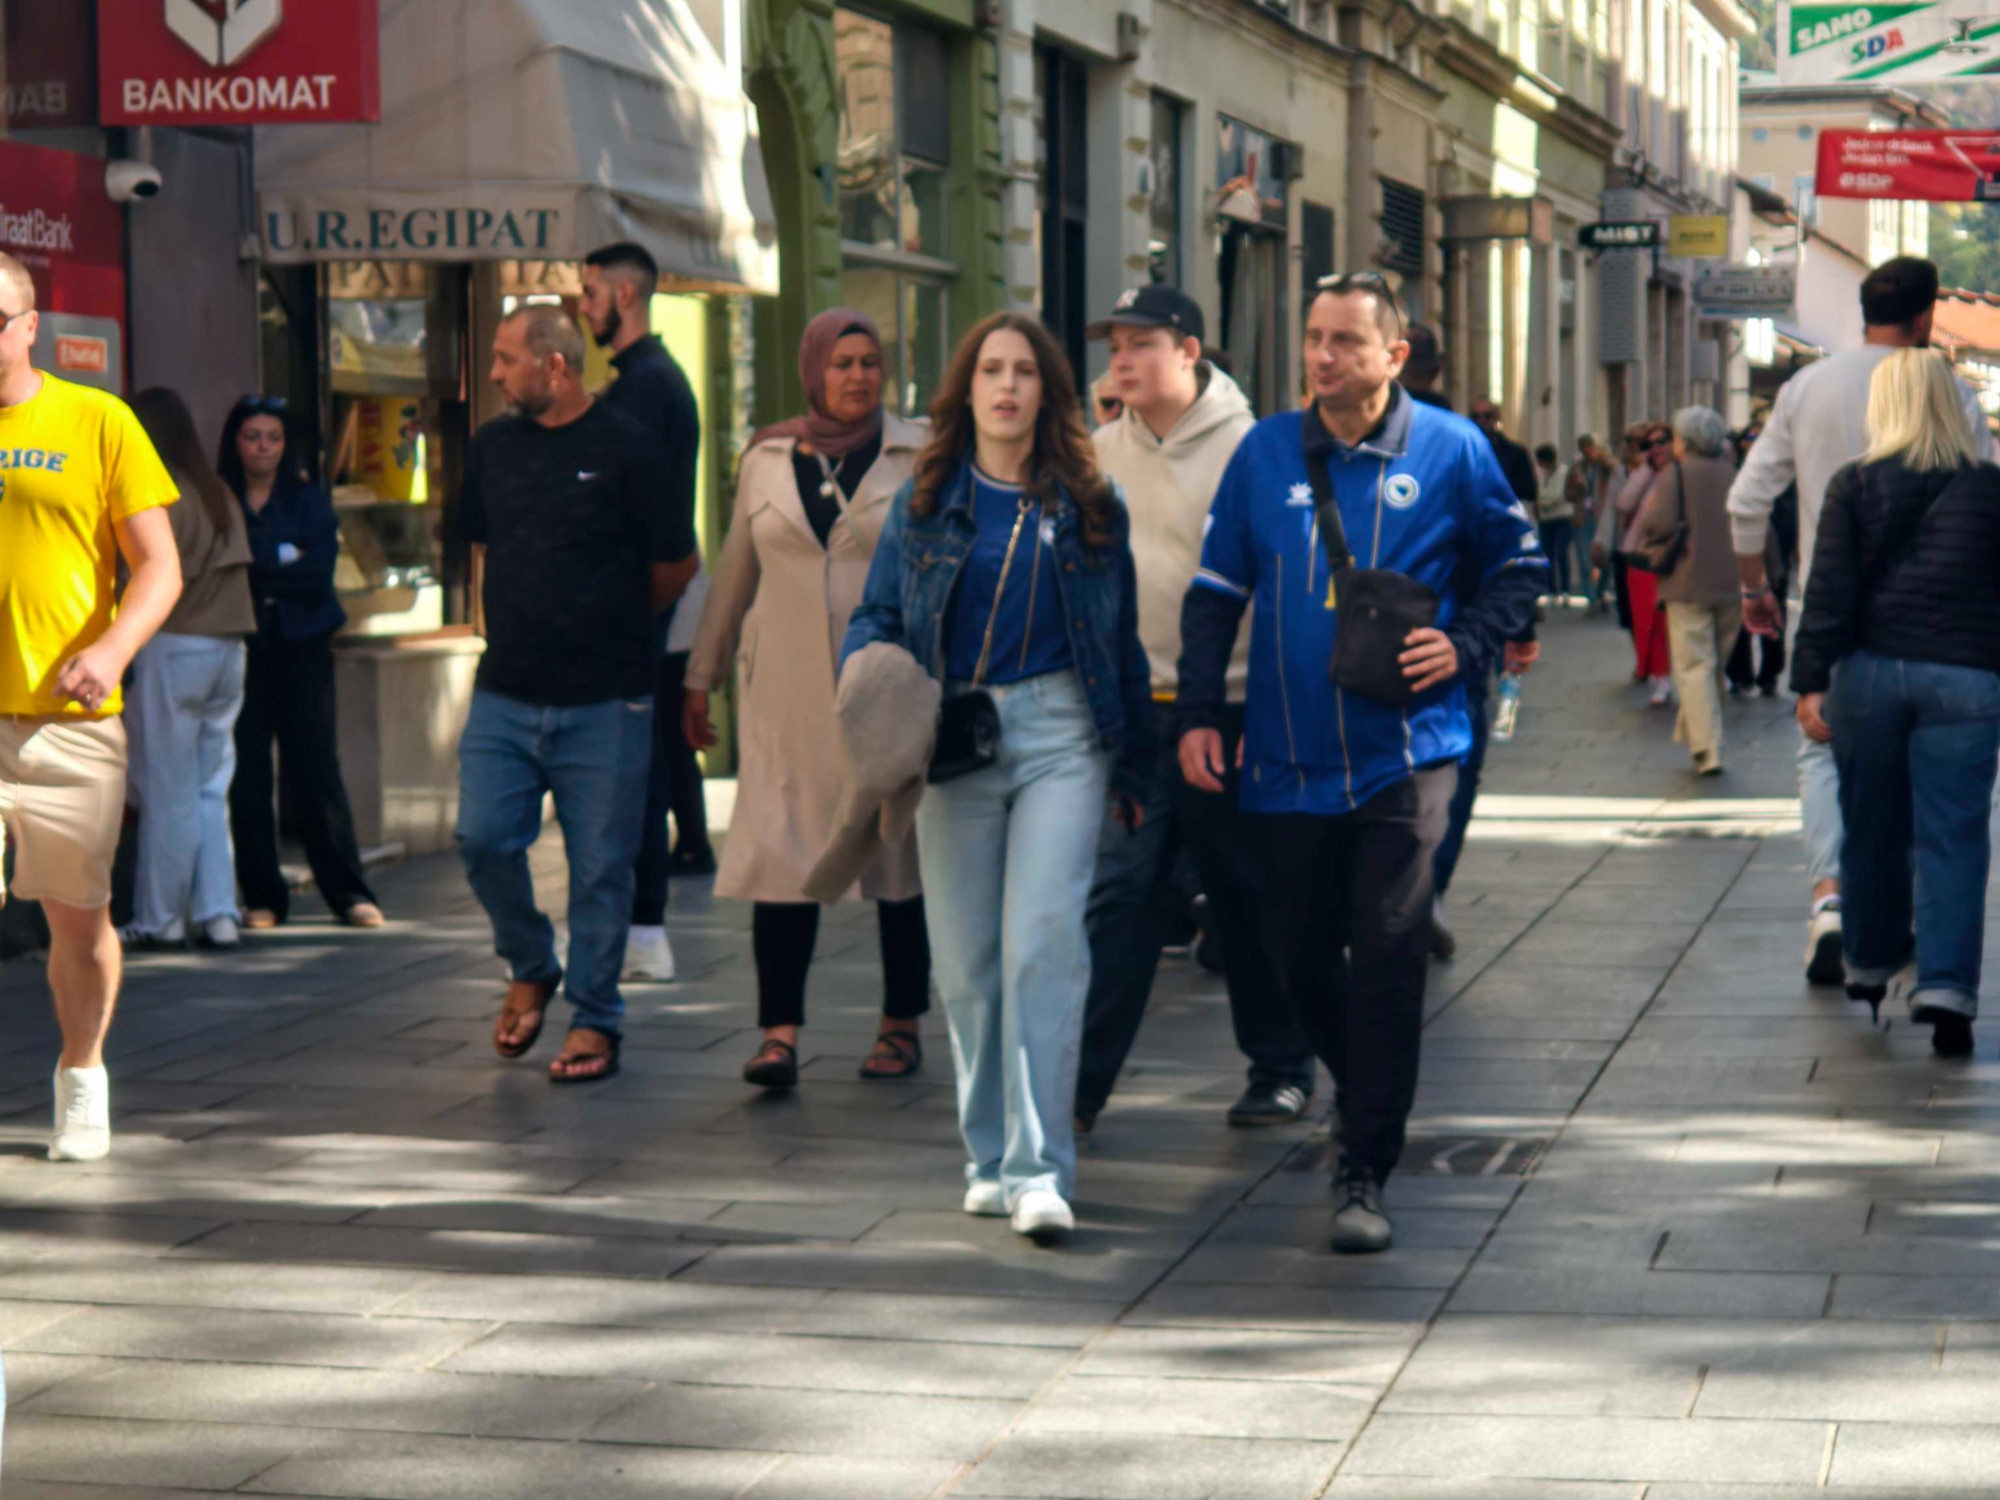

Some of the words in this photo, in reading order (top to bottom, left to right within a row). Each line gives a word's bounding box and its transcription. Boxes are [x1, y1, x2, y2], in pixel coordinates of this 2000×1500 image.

[1796, 7, 1873, 49] SAMO
[1851, 27, 1905, 65] SDA
[122, 74, 337, 113] BANKOMAT
[267, 207, 560, 251] U.R.EGIPAT
[0, 447, 68, 474] RIGE
